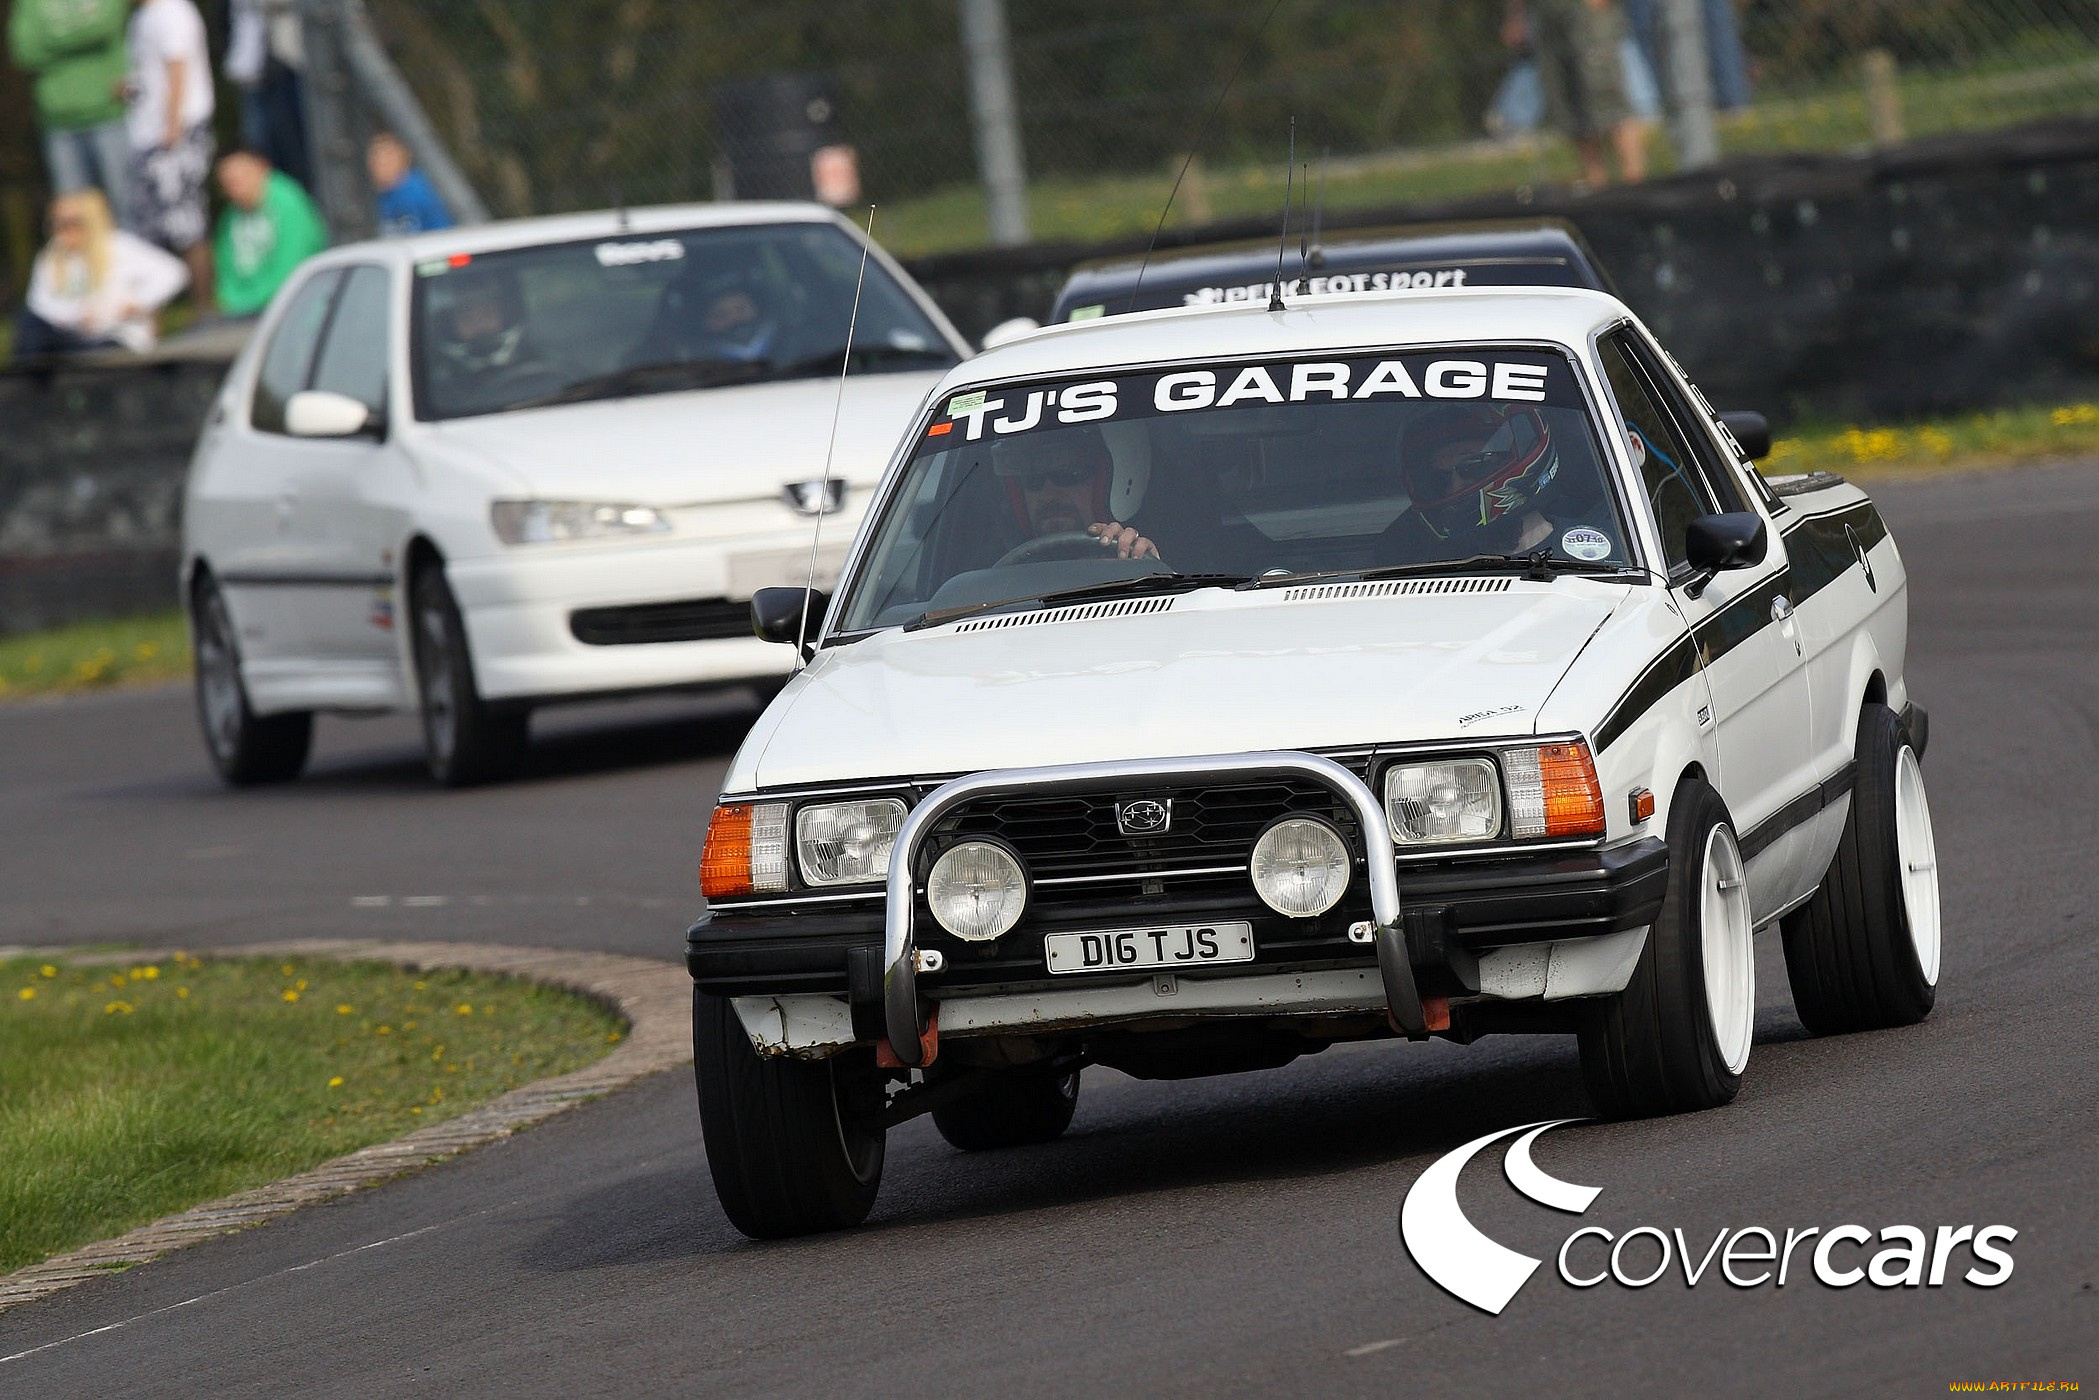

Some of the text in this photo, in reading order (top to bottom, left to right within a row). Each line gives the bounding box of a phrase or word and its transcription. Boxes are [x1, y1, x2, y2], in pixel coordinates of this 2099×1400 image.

[951, 359, 1549, 441] TJ'S GARAGE
[1080, 928, 1219, 967] D16 TJS
